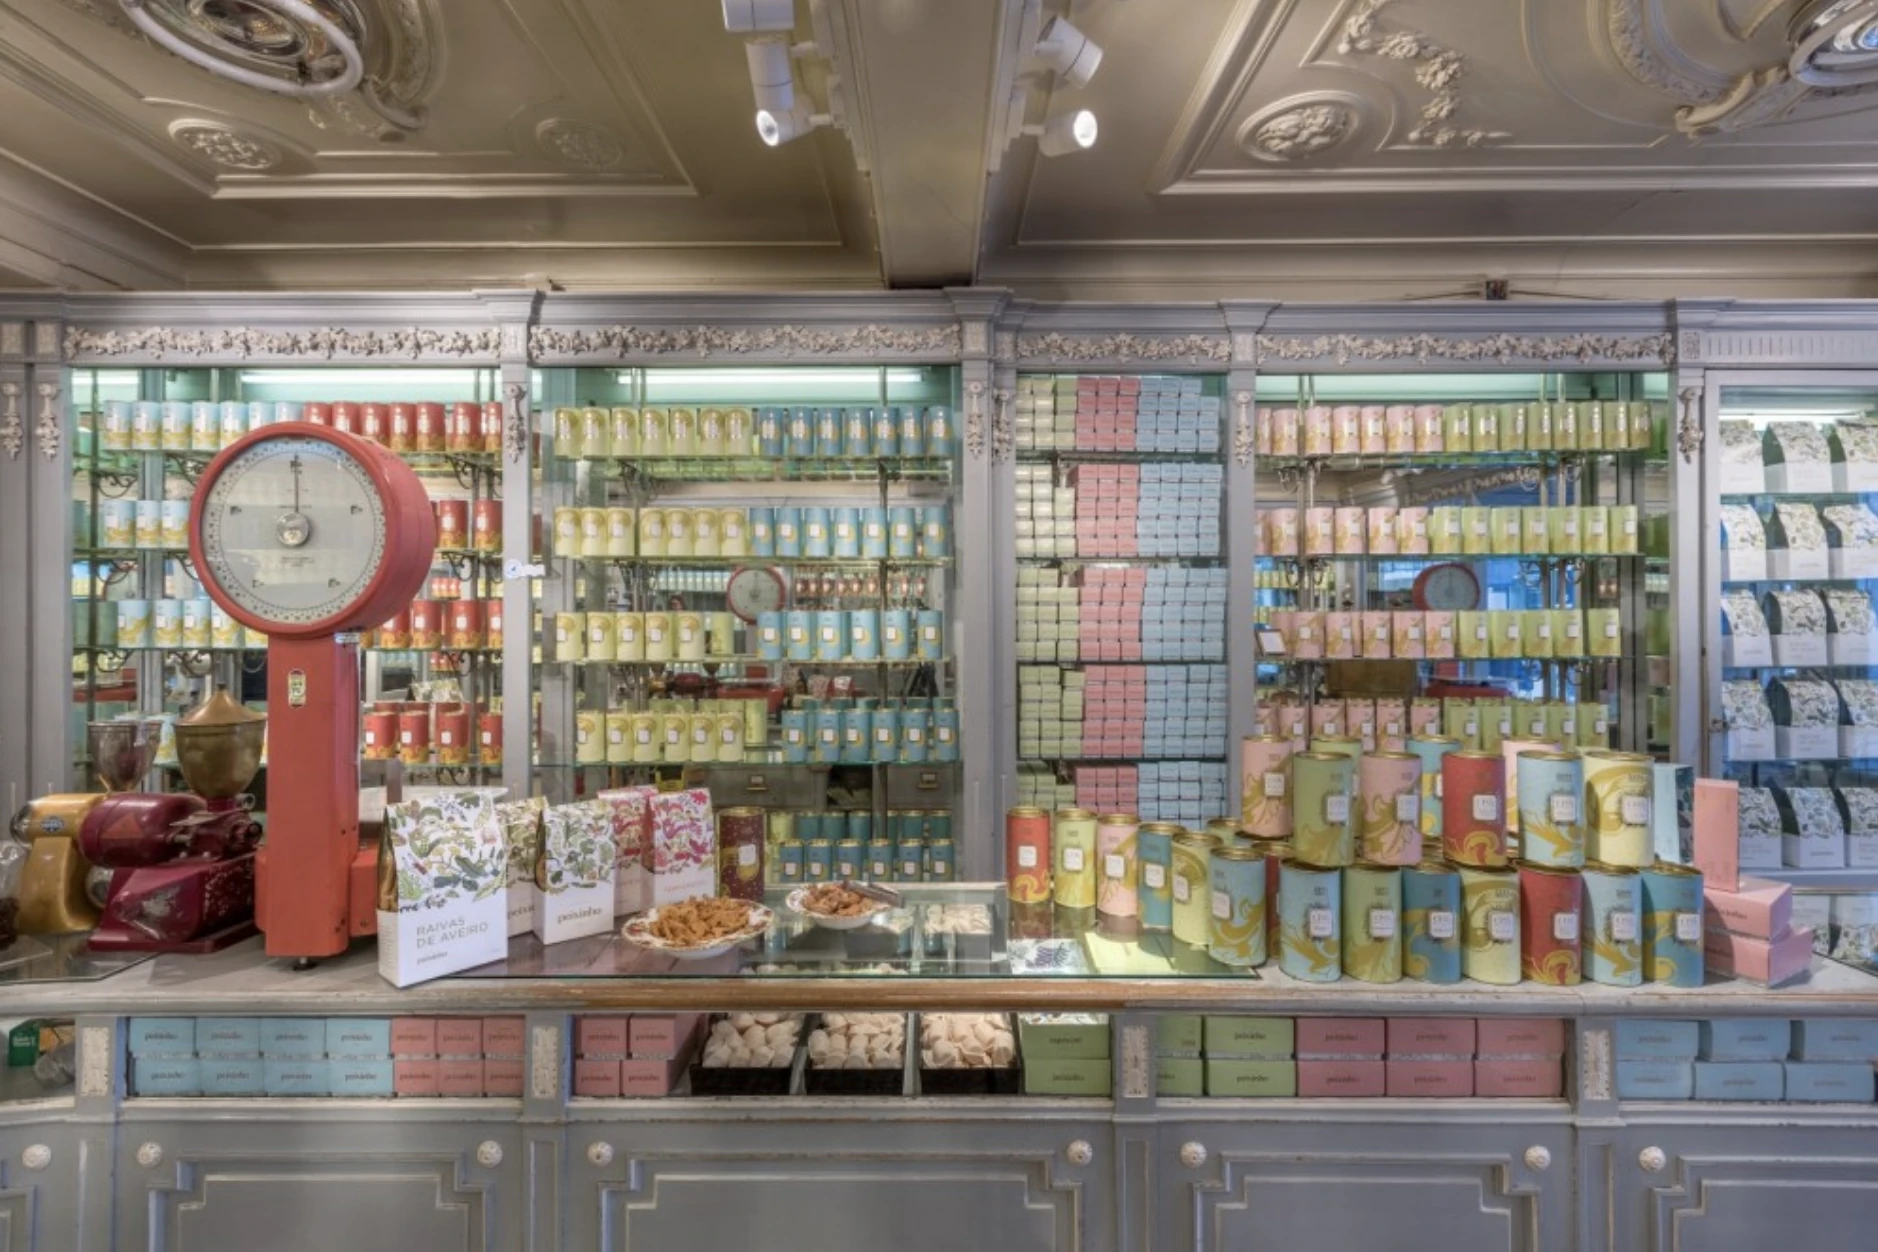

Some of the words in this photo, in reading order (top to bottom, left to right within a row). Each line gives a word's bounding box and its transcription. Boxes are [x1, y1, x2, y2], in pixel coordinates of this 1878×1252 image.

[557, 906, 603, 924] peixinho
[416, 917, 465, 936] RAIVAS
[416, 937, 436, 949] DE
[439, 922, 488, 943] AVEIRO
